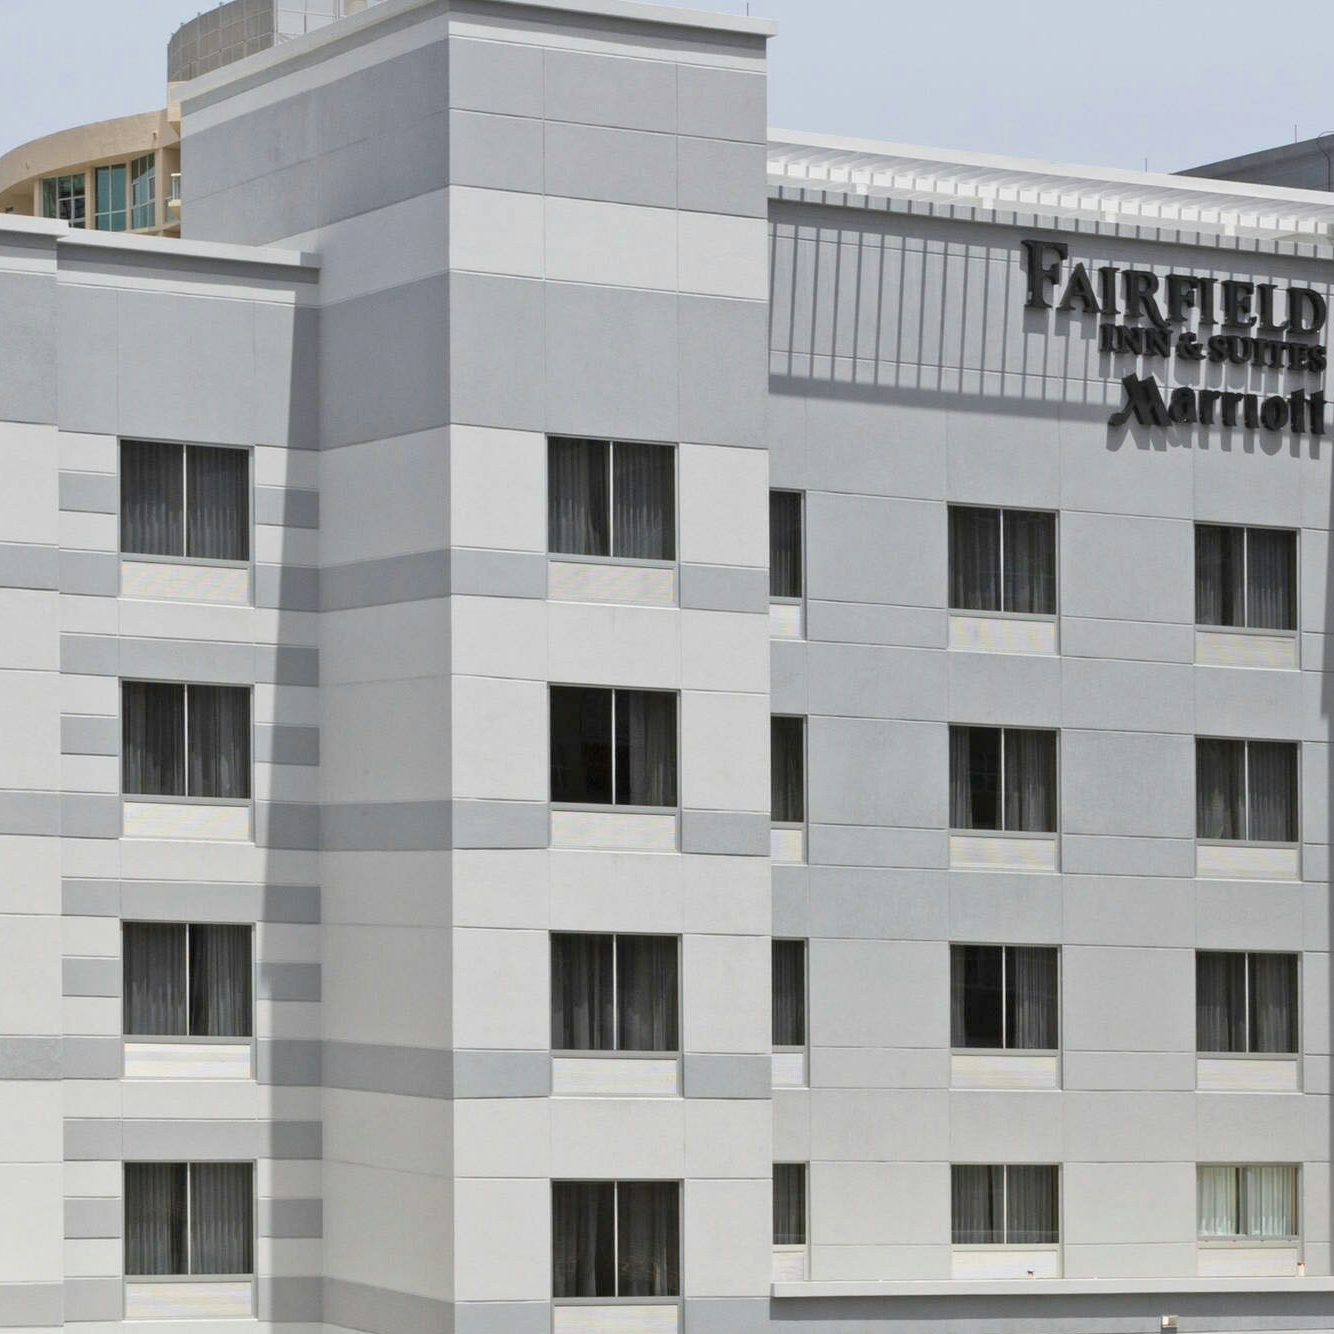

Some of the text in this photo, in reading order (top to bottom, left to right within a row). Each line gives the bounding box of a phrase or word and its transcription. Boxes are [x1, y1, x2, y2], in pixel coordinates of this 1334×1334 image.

[1021, 239, 1327, 335] FAIRFIELD
[1100, 324, 1327, 373] INN & SUITES
[1107, 372, 1327, 435] Marriott
